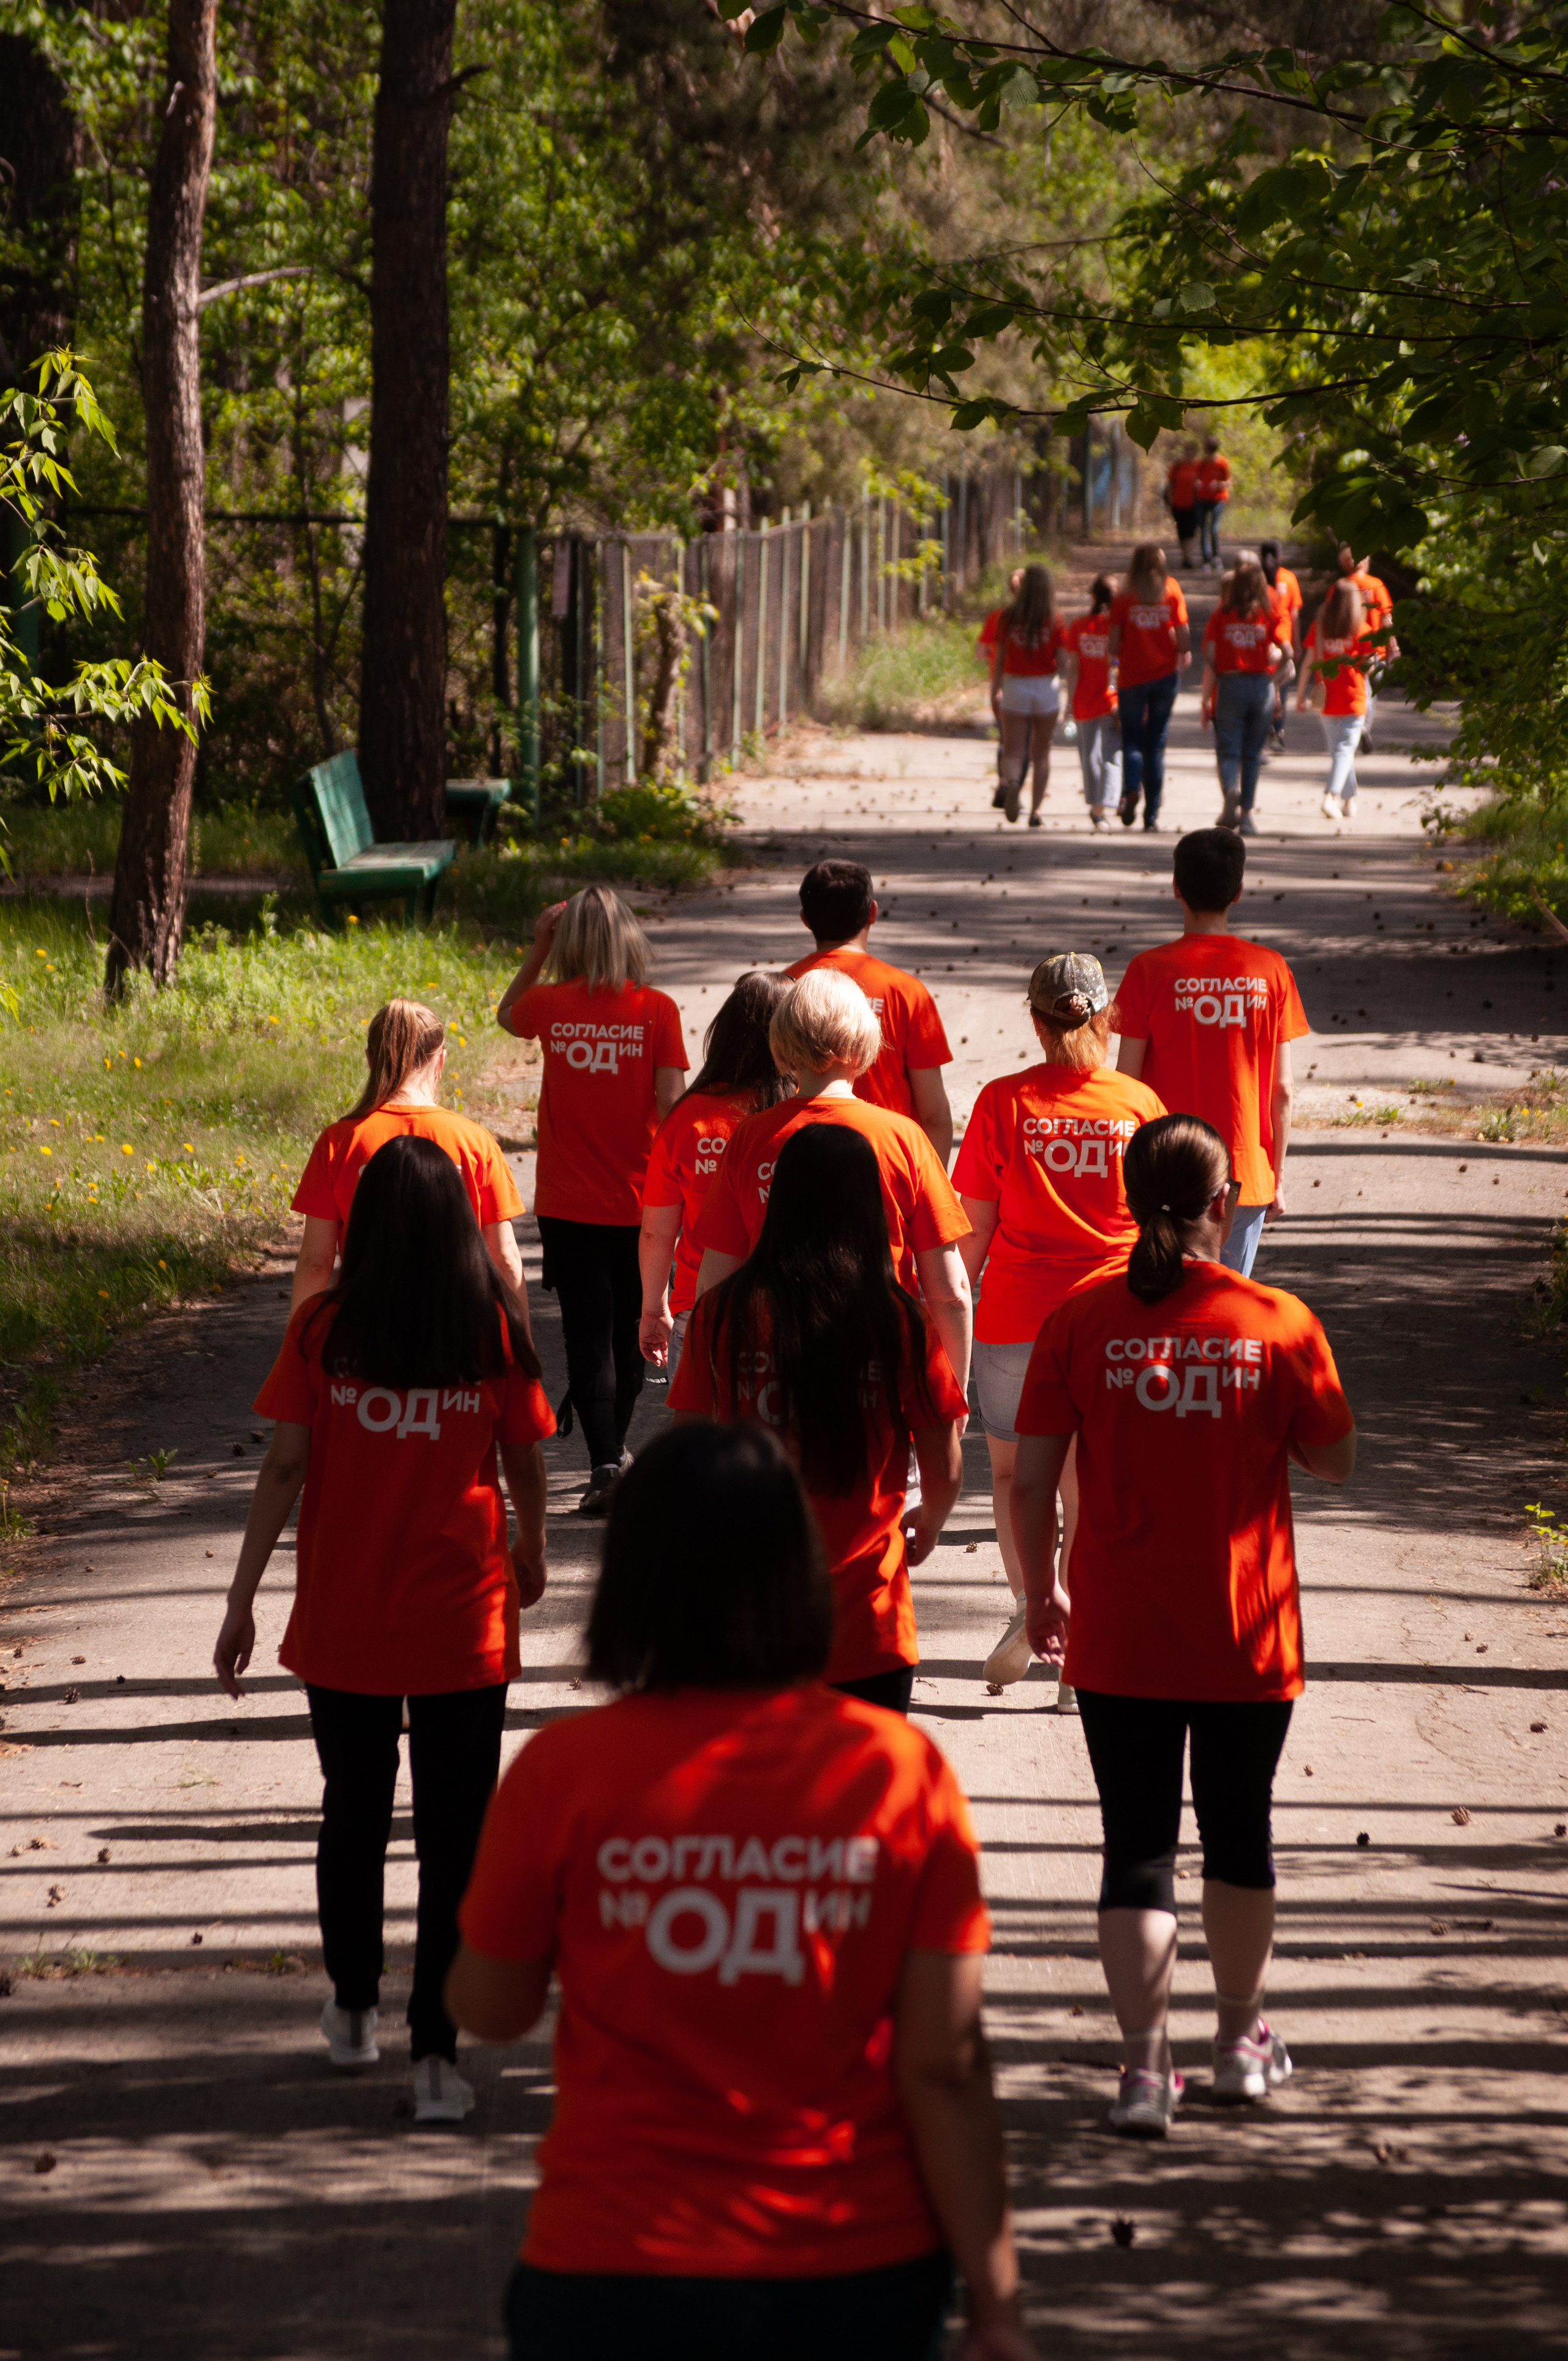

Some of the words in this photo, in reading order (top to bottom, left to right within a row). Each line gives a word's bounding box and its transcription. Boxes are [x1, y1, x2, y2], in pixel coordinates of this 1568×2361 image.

[1175, 977, 1267, 993] СОГЛАСИЕ
[551, 1022, 644, 1040] СОГЛАСИЕ
[1023, 1118, 1135, 1136] СОГЛАСИЕ
[1105, 1337, 1262, 1362] СОГЛАСИЕ
[597, 1835, 880, 1883] СОГЛАСИЕ
